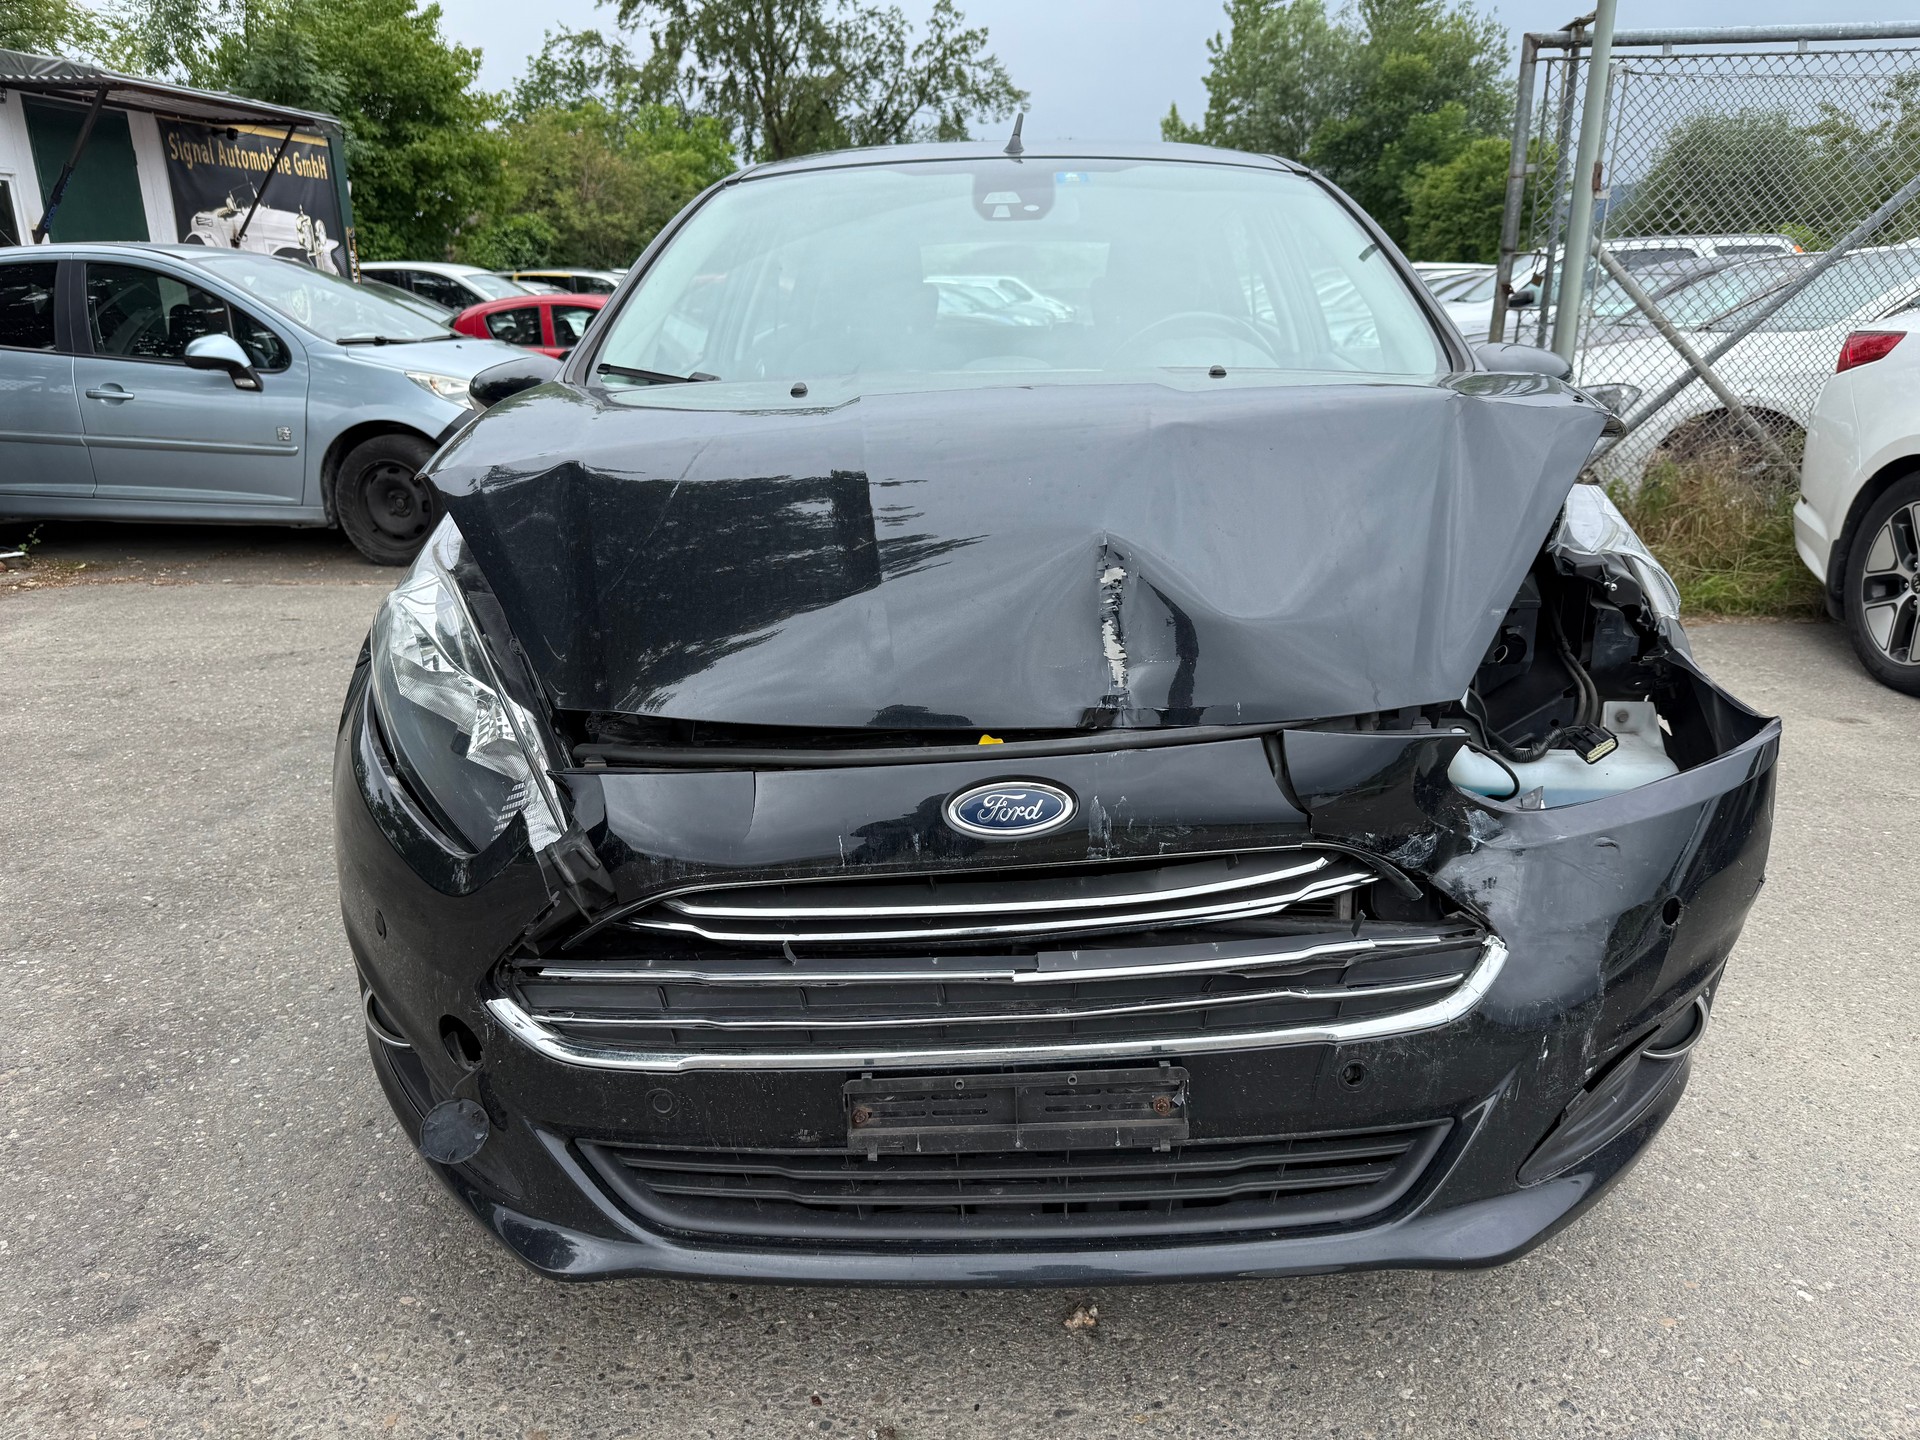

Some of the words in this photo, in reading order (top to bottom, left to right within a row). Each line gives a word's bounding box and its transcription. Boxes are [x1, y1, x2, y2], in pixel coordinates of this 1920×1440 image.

[169, 132, 214, 170] Signal
[293, 151, 328, 180] GmbH
[977, 793, 1044, 823] Ford
